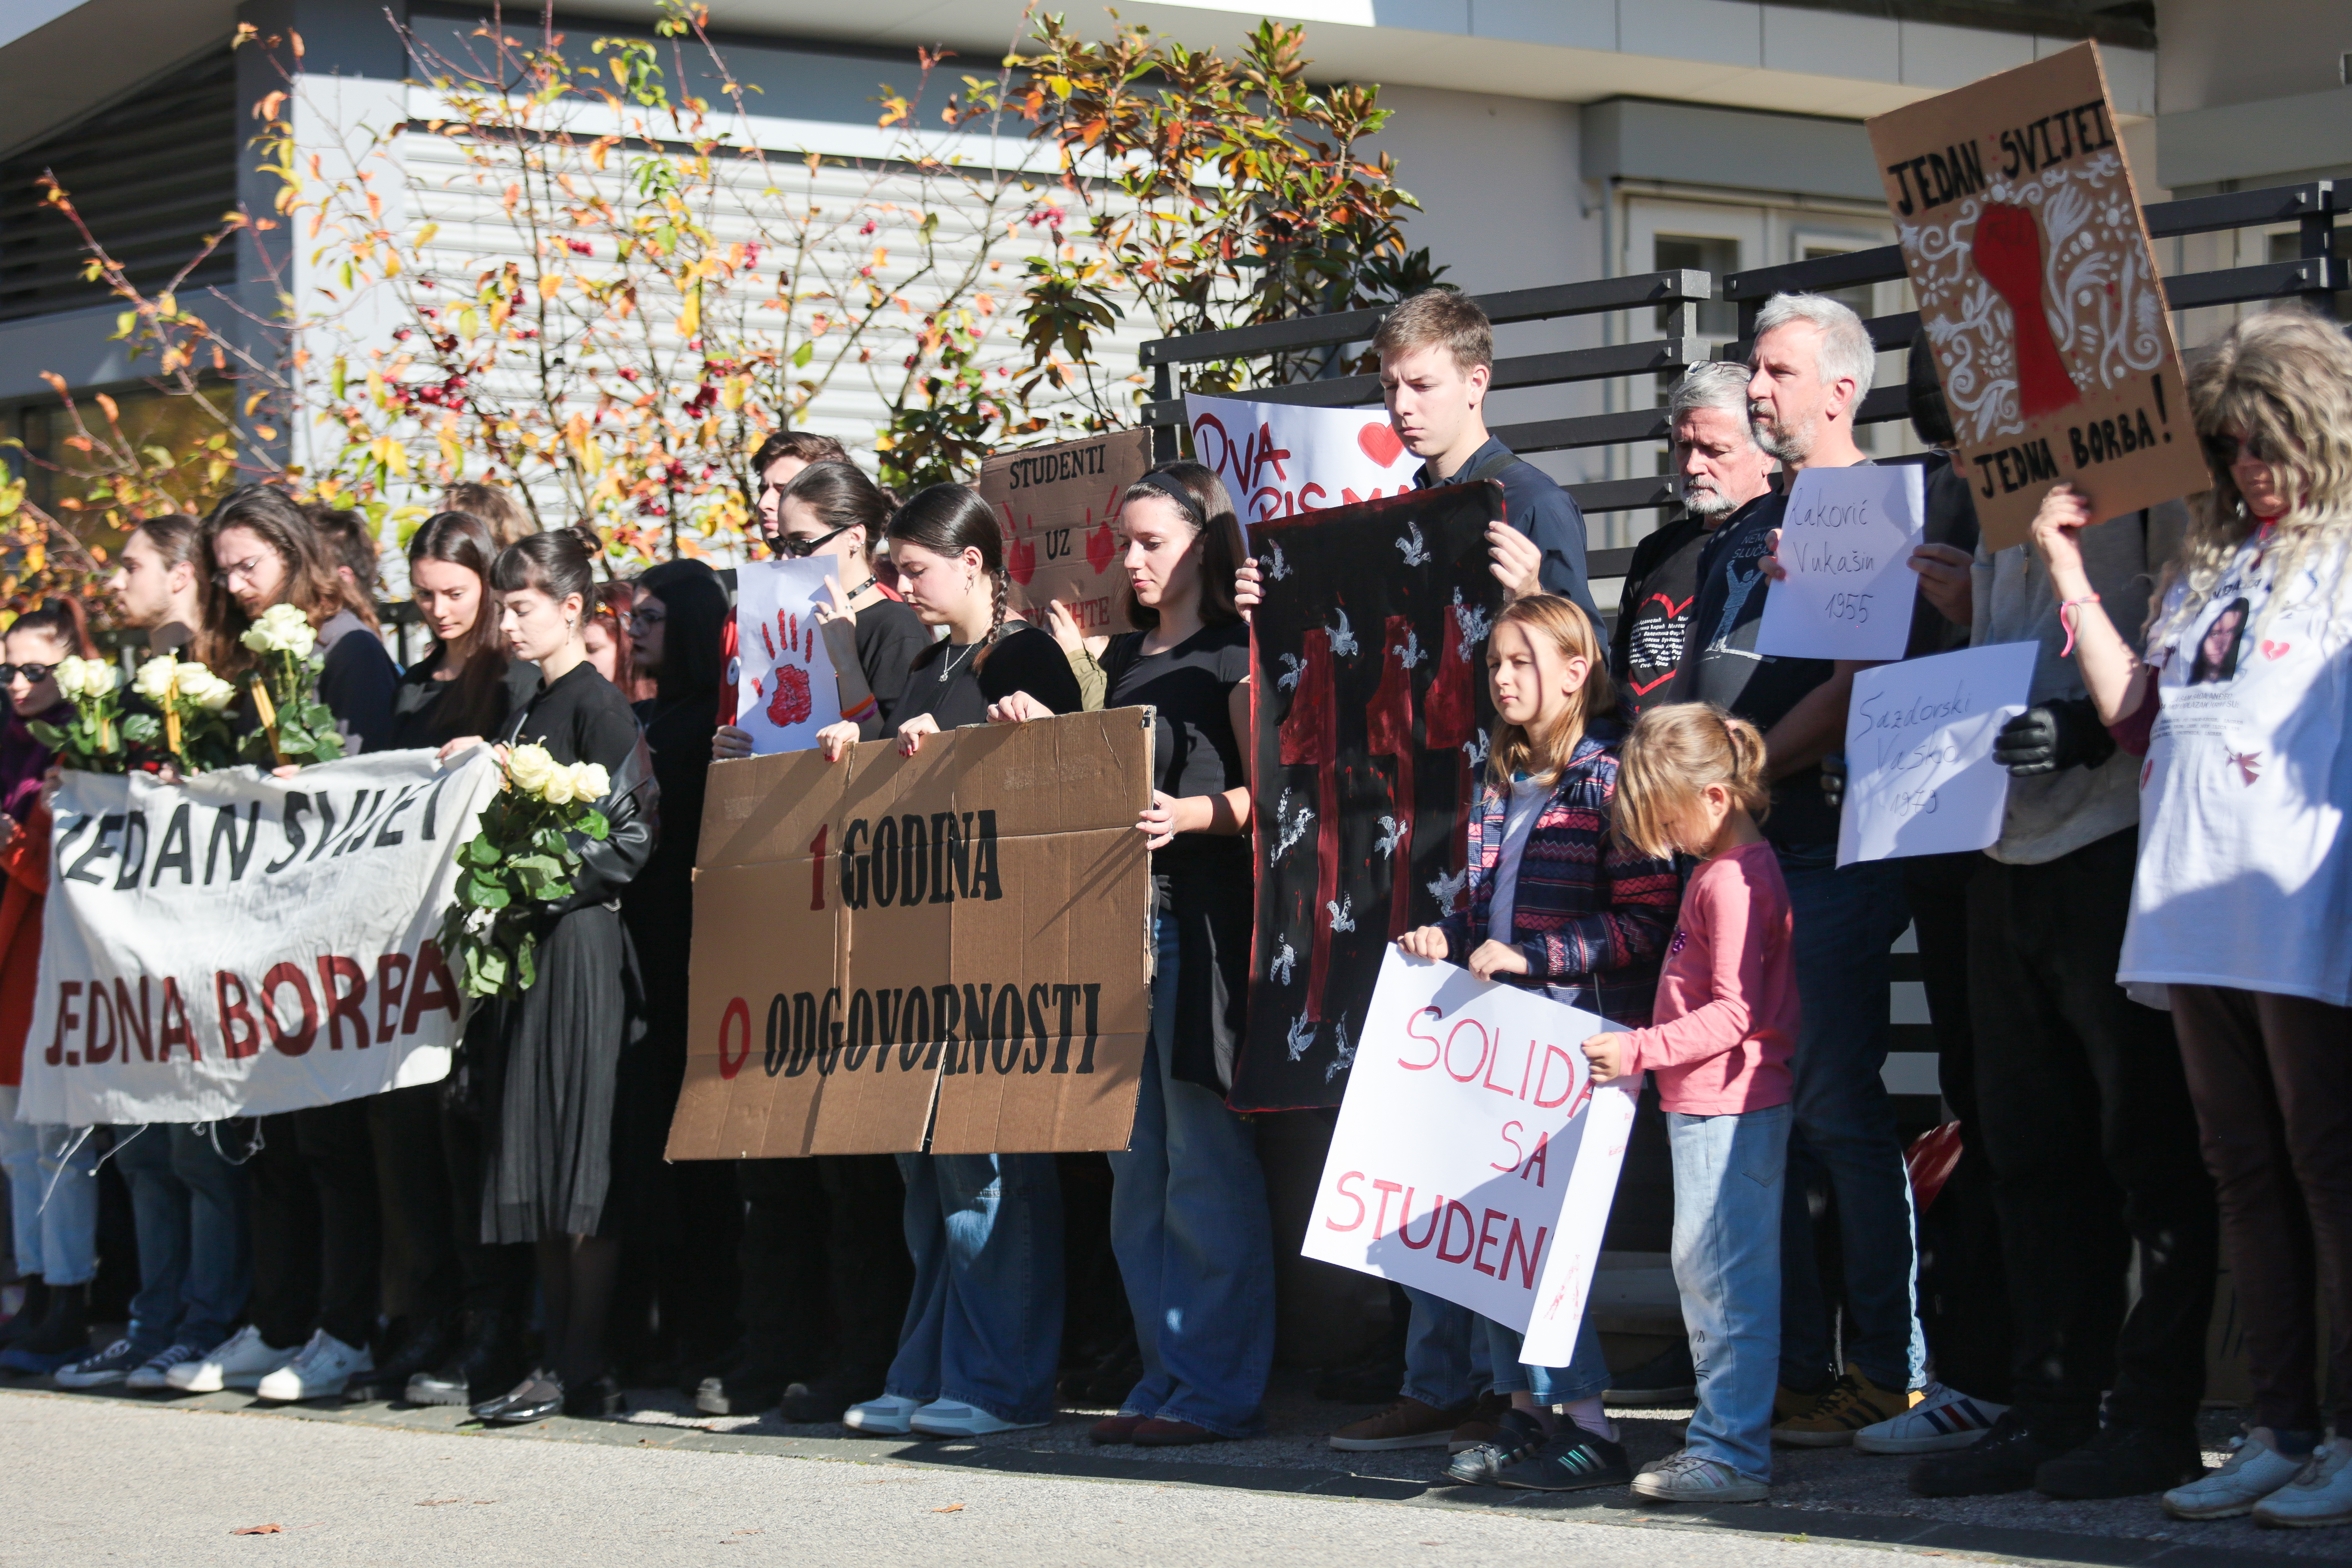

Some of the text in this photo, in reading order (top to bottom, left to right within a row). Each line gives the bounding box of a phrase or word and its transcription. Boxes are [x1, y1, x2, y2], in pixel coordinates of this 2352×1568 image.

[1887, 140, 1985, 215] JEDAN
[1009, 444, 1106, 490] STUDENTI
[1193, 413, 1291, 496] DVA
[1973, 438, 2059, 498] JEDNA
[1045, 529, 1071, 560] UZ
[1732, 544, 1770, 558] SLUČA
[1741, 532, 1766, 544] NEM
[1793, 541, 1874, 575] Vukašin
[1825, 593, 1873, 623] 1955
[1878, 725, 1956, 775] Vasko
[1890, 789, 1937, 816] 1979
[809, 810, 1002, 910] 1 GODINA
[46, 939, 460, 1066] JEDNA BORBA
[764, 983, 1101, 1077] ODGOVORNOSTI
[1490, 1120, 1548, 1188] SA
[1326, 1171, 1554, 1290] STUDEN
